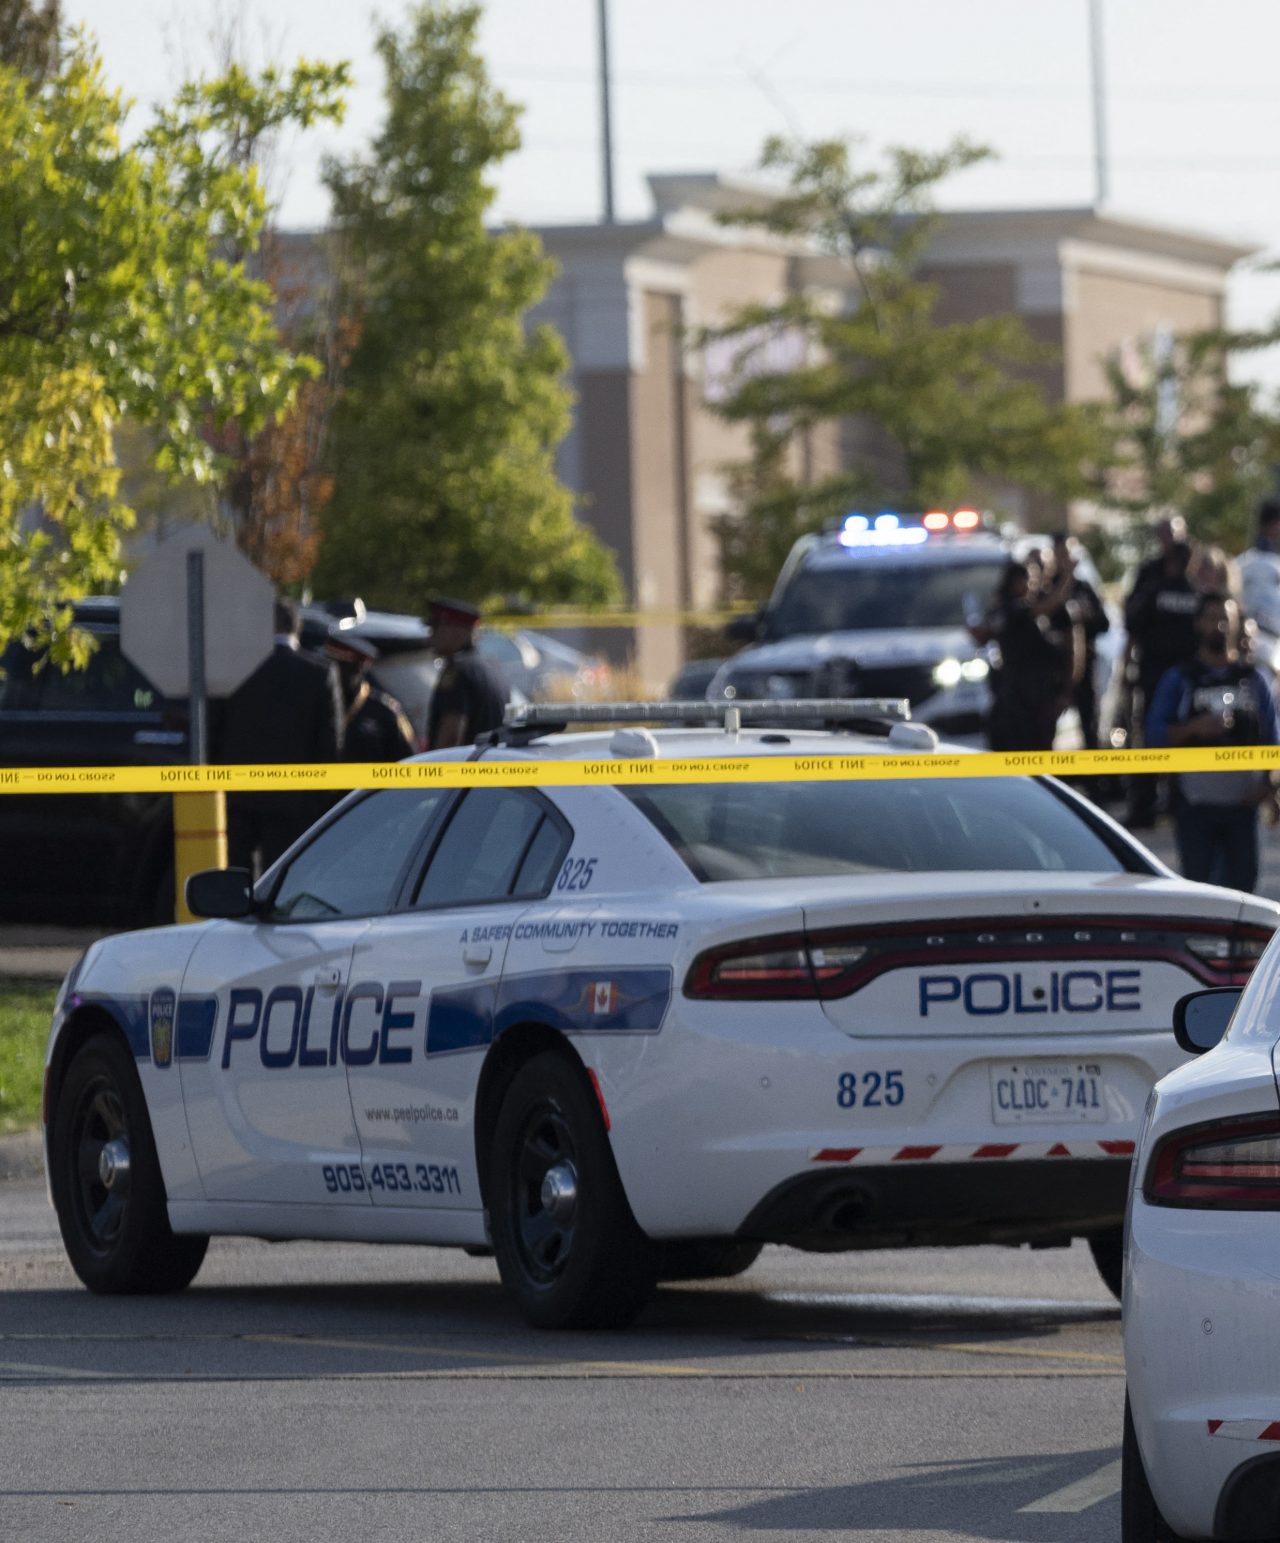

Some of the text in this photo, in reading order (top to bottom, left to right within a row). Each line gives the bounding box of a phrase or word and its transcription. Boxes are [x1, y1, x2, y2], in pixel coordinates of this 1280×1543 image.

[557, 857, 598, 890] 825
[459, 921, 679, 943] A SAFER COMMUNITY TOGETHER
[919, 969, 1141, 1017] POLICE
[221, 980, 422, 1069] POLICE
[837, 1071, 904, 1108] 825
[997, 1078, 1100, 1110] CLDC 741
[364, 1103, 459, 1124] www.peelpolice.ca
[322, 1163, 461, 1195] 905.453.3311
